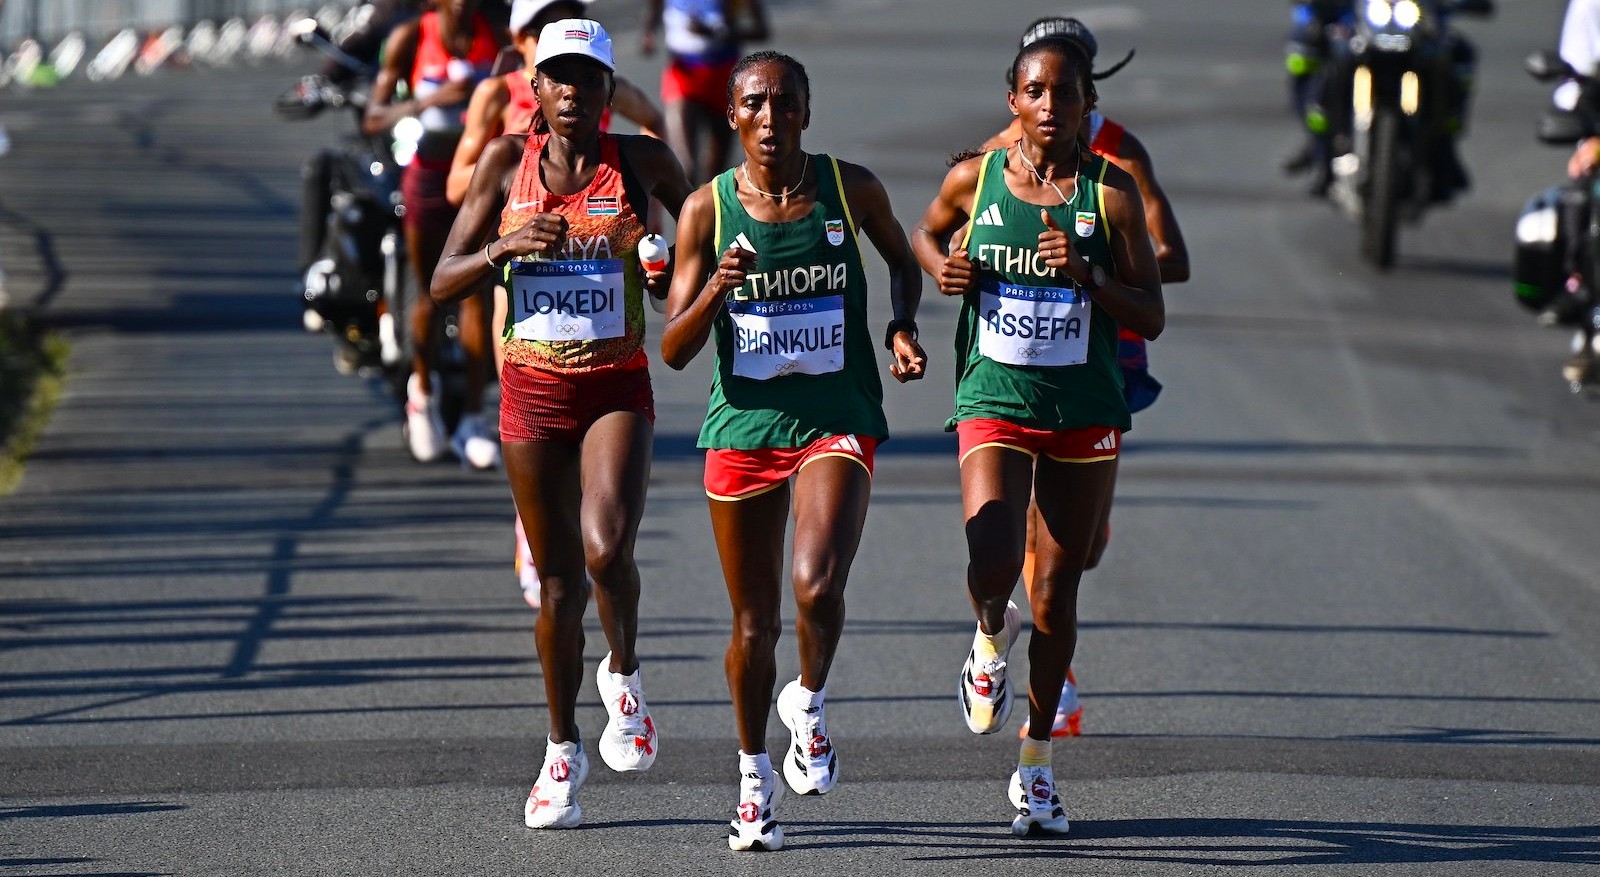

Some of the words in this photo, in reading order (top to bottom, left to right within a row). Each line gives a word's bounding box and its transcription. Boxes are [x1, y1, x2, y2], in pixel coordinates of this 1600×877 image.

[524, 234, 612, 261] NYA
[978, 244, 1090, 278] ETHIO
[536, 265, 565, 273] PARIS
[567, 264, 595, 272] 2024
[733, 262, 847, 301] ETHIOPIA
[522, 287, 614, 315] LOKEDI
[755, 302, 785, 313] PARIS
[787, 302, 814, 312] 2024
[1005, 288, 1034, 298] PARIS
[1037, 289, 1064, 299] 2024
[735, 323, 843, 355] SHANKULE
[986, 309, 1081, 341] ASSEFA
